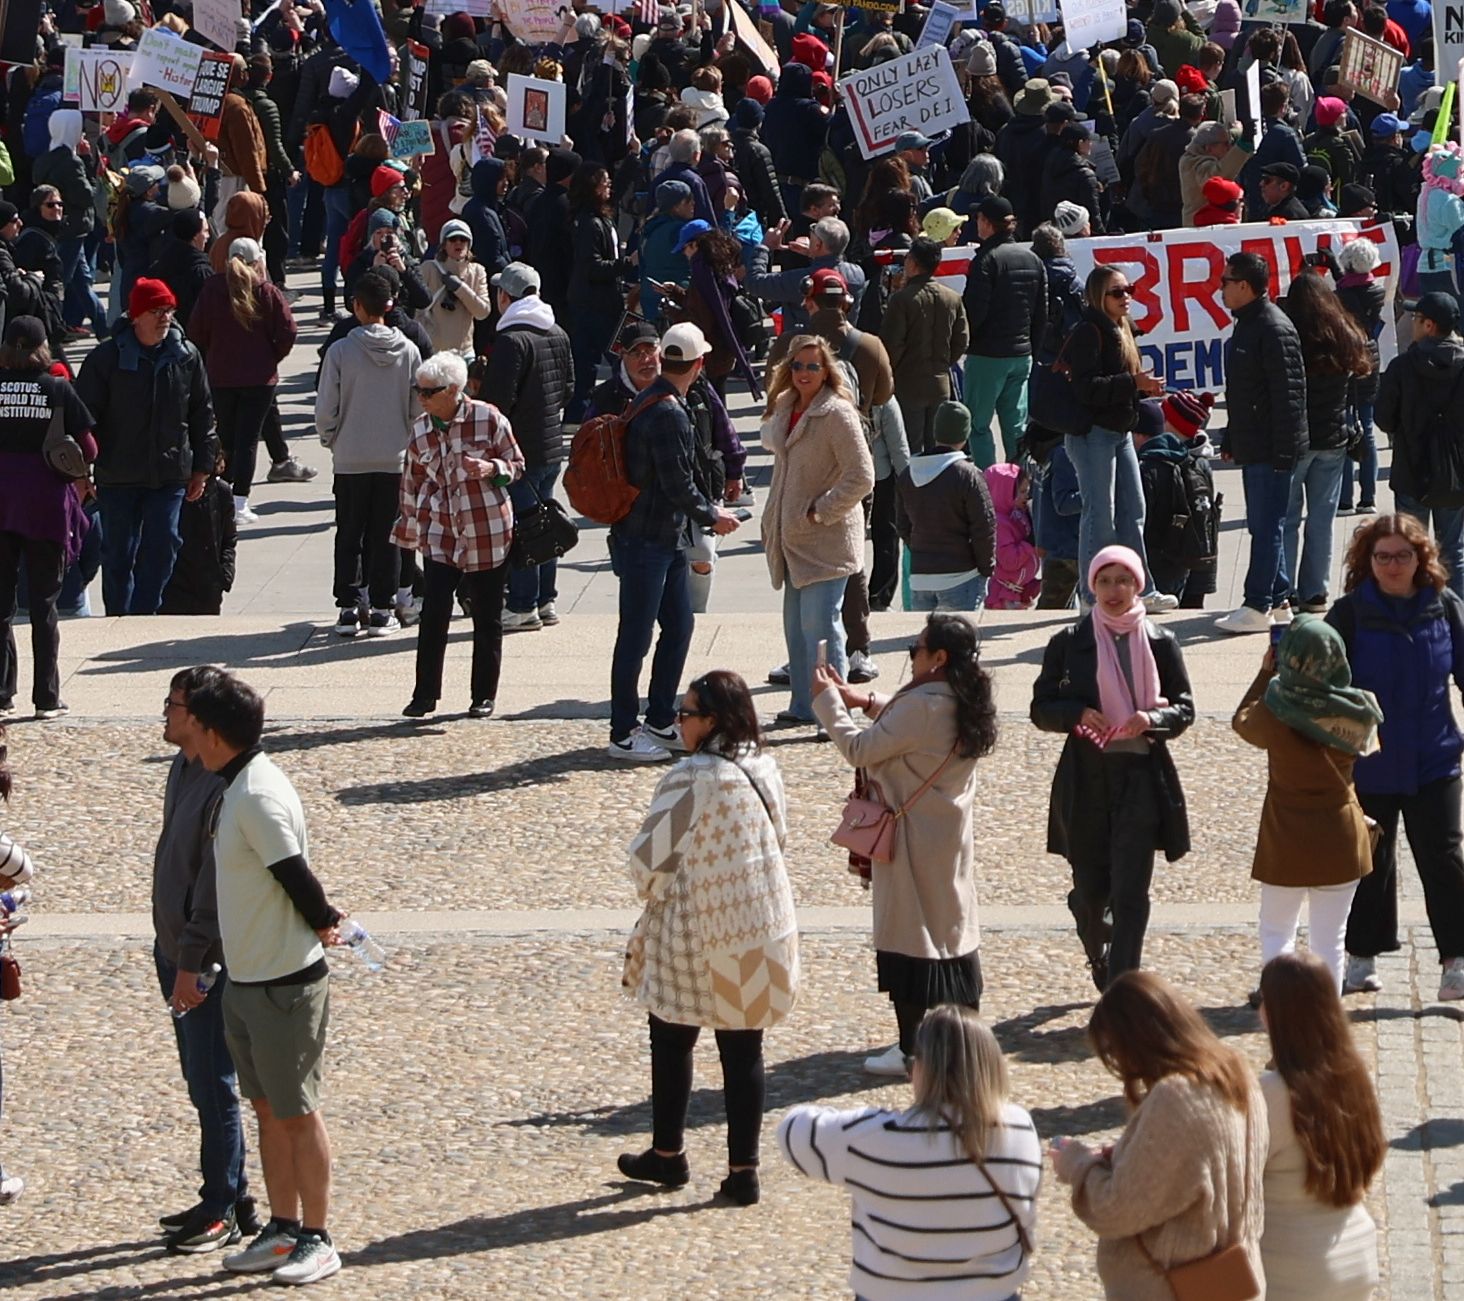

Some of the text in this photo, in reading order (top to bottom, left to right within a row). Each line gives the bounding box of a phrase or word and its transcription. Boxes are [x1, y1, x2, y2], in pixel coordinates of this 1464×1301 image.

[143, 32, 171, 49] Don't
[217, 62, 230, 76] SE
[855, 50, 940, 94] ONLY LAZY
[193, 79, 226, 96] LARGUE
[190, 95, 220, 113] TRUMP
[867, 76, 941, 120] LOSERS
[873, 97, 955, 141] FEAR D.E.I.
[0, 381, 42, 394] SCOTUS:
[29, 394, 48, 407] THE
